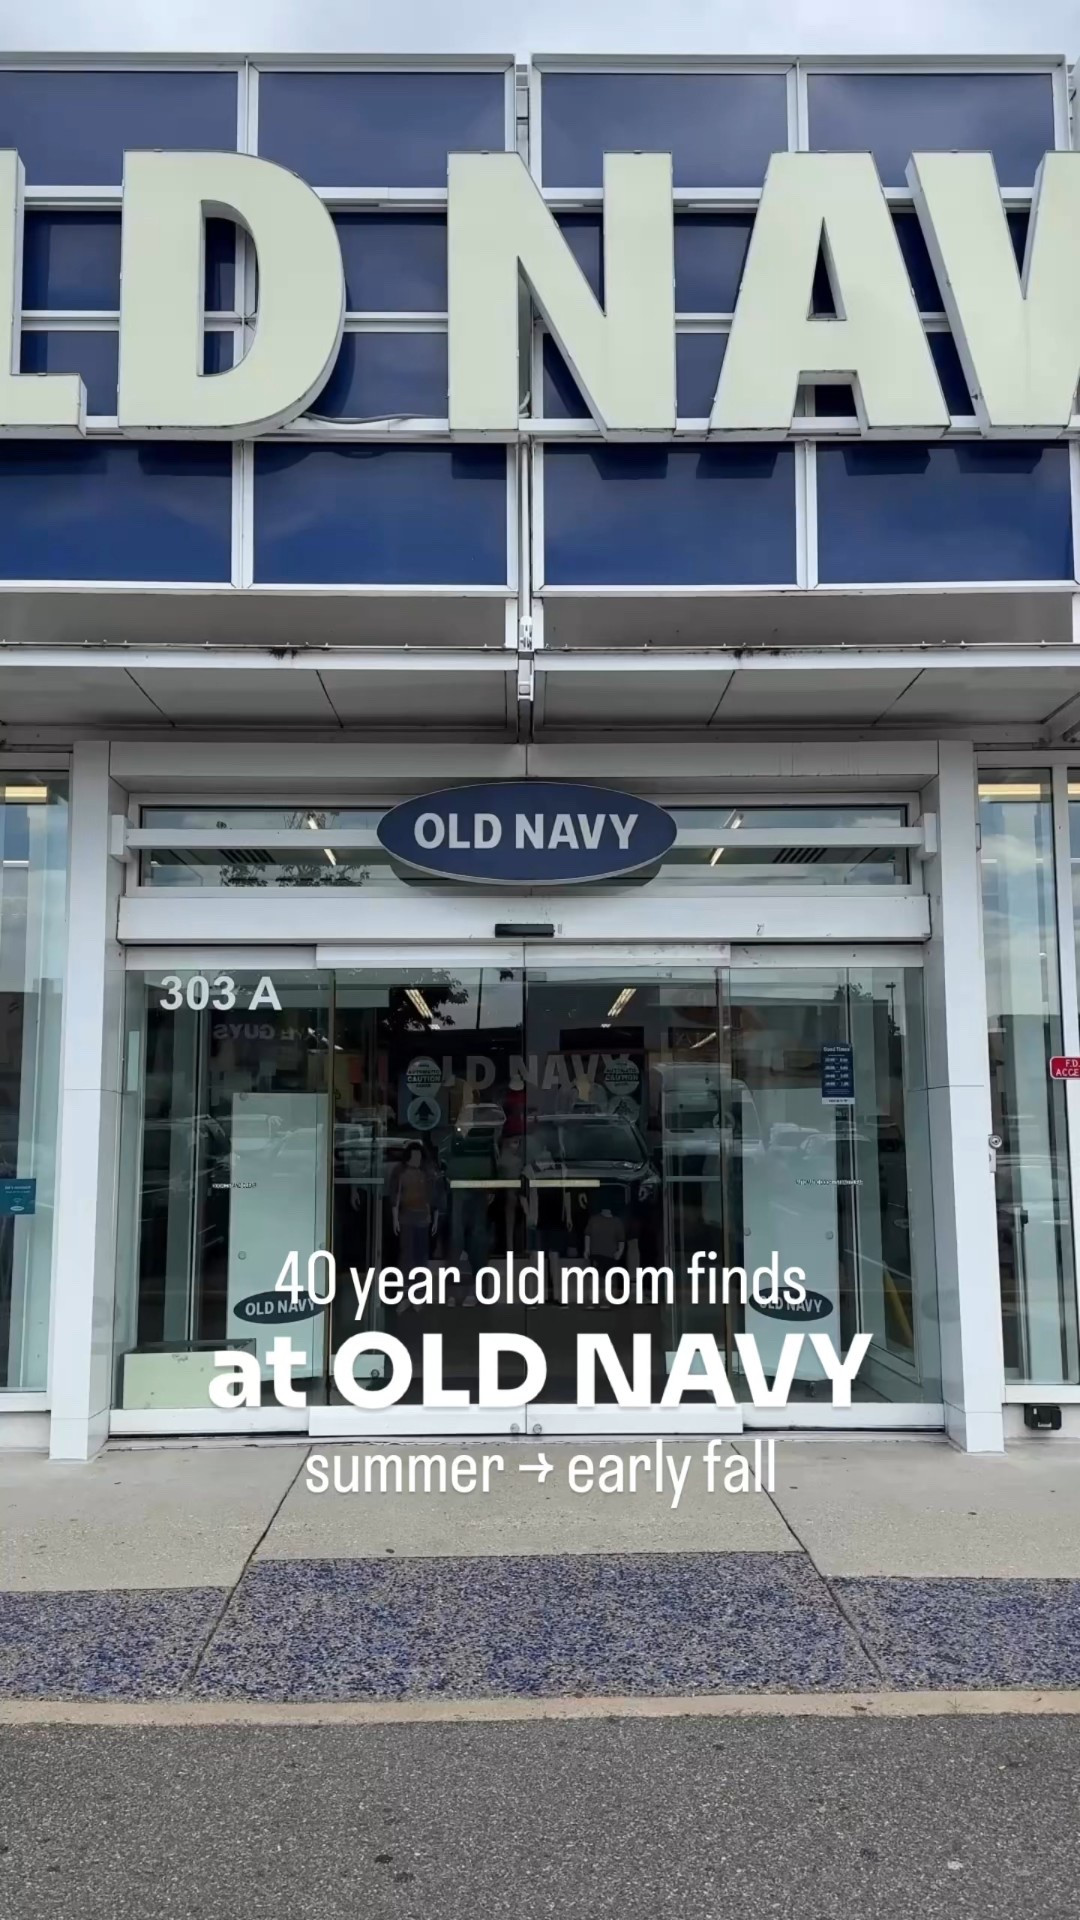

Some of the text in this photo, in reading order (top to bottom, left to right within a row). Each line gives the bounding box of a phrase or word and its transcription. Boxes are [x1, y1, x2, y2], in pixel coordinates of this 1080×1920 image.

[414, 812, 639, 850] OLD NAVY
[159, 975, 283, 1011] 303 A
[407, 1075, 442, 1083] CAUTION
[245, 1301, 274, 1316] OLD
